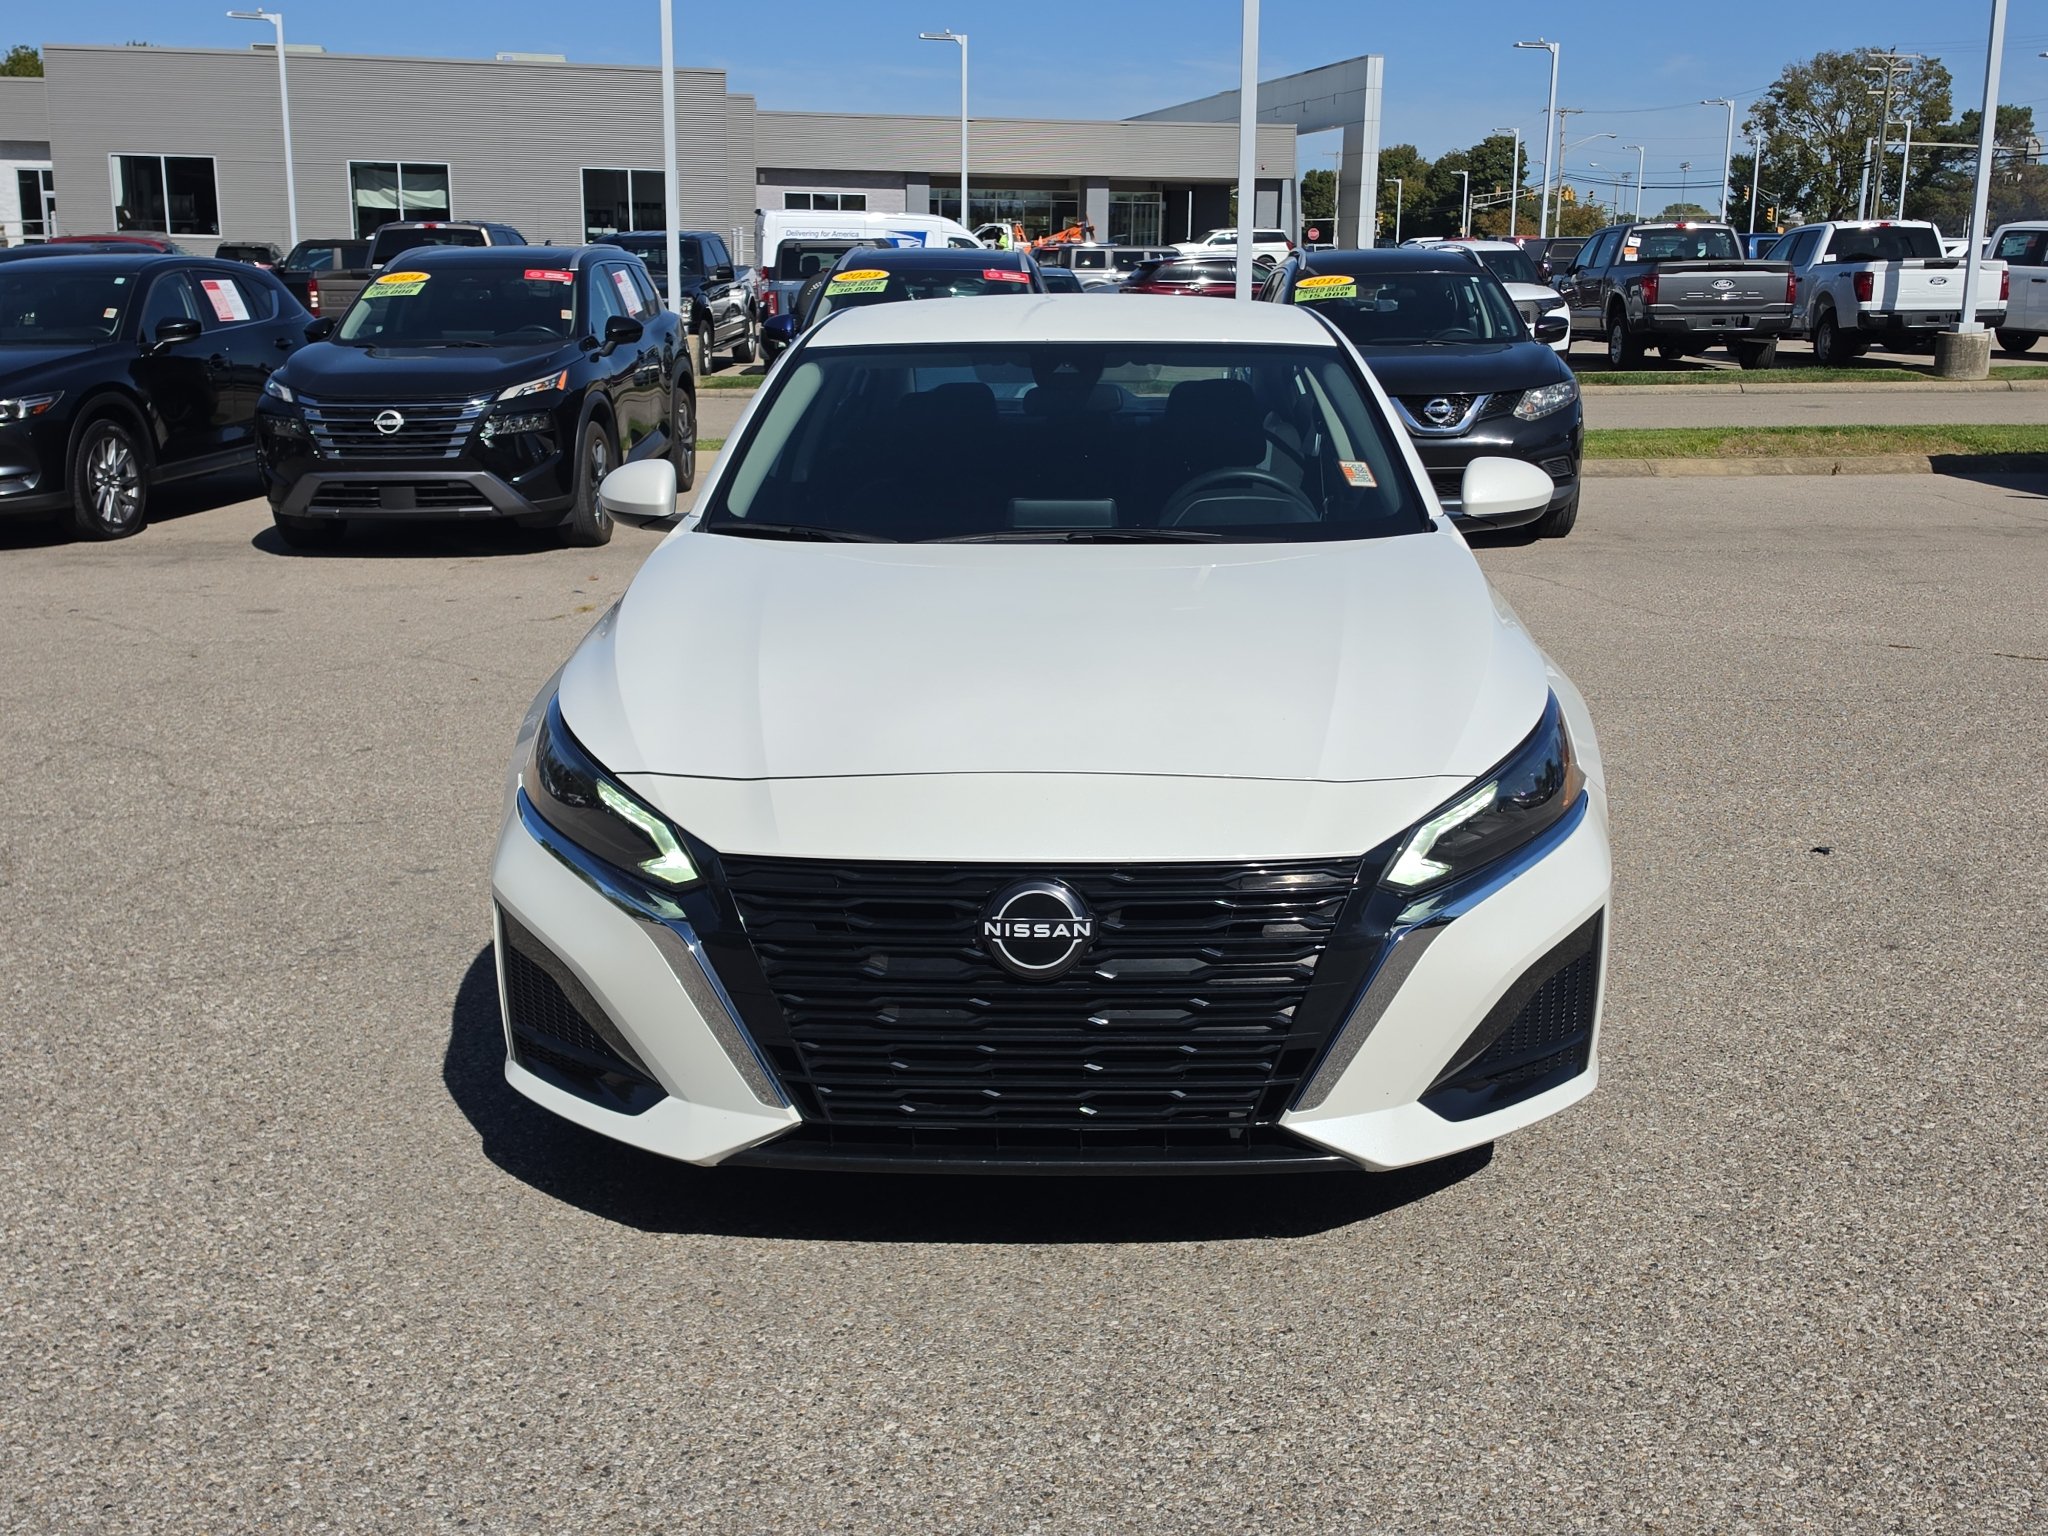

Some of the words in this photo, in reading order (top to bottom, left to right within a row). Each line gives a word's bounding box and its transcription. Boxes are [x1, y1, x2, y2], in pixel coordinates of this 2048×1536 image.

[785, 230, 819, 238] Delivering
[842, 272, 881, 280] 2023
[1306, 277, 1344, 286] 2016
[1299, 287, 1325, 295] PRICED
[984, 921, 1091, 938] NISSAN
